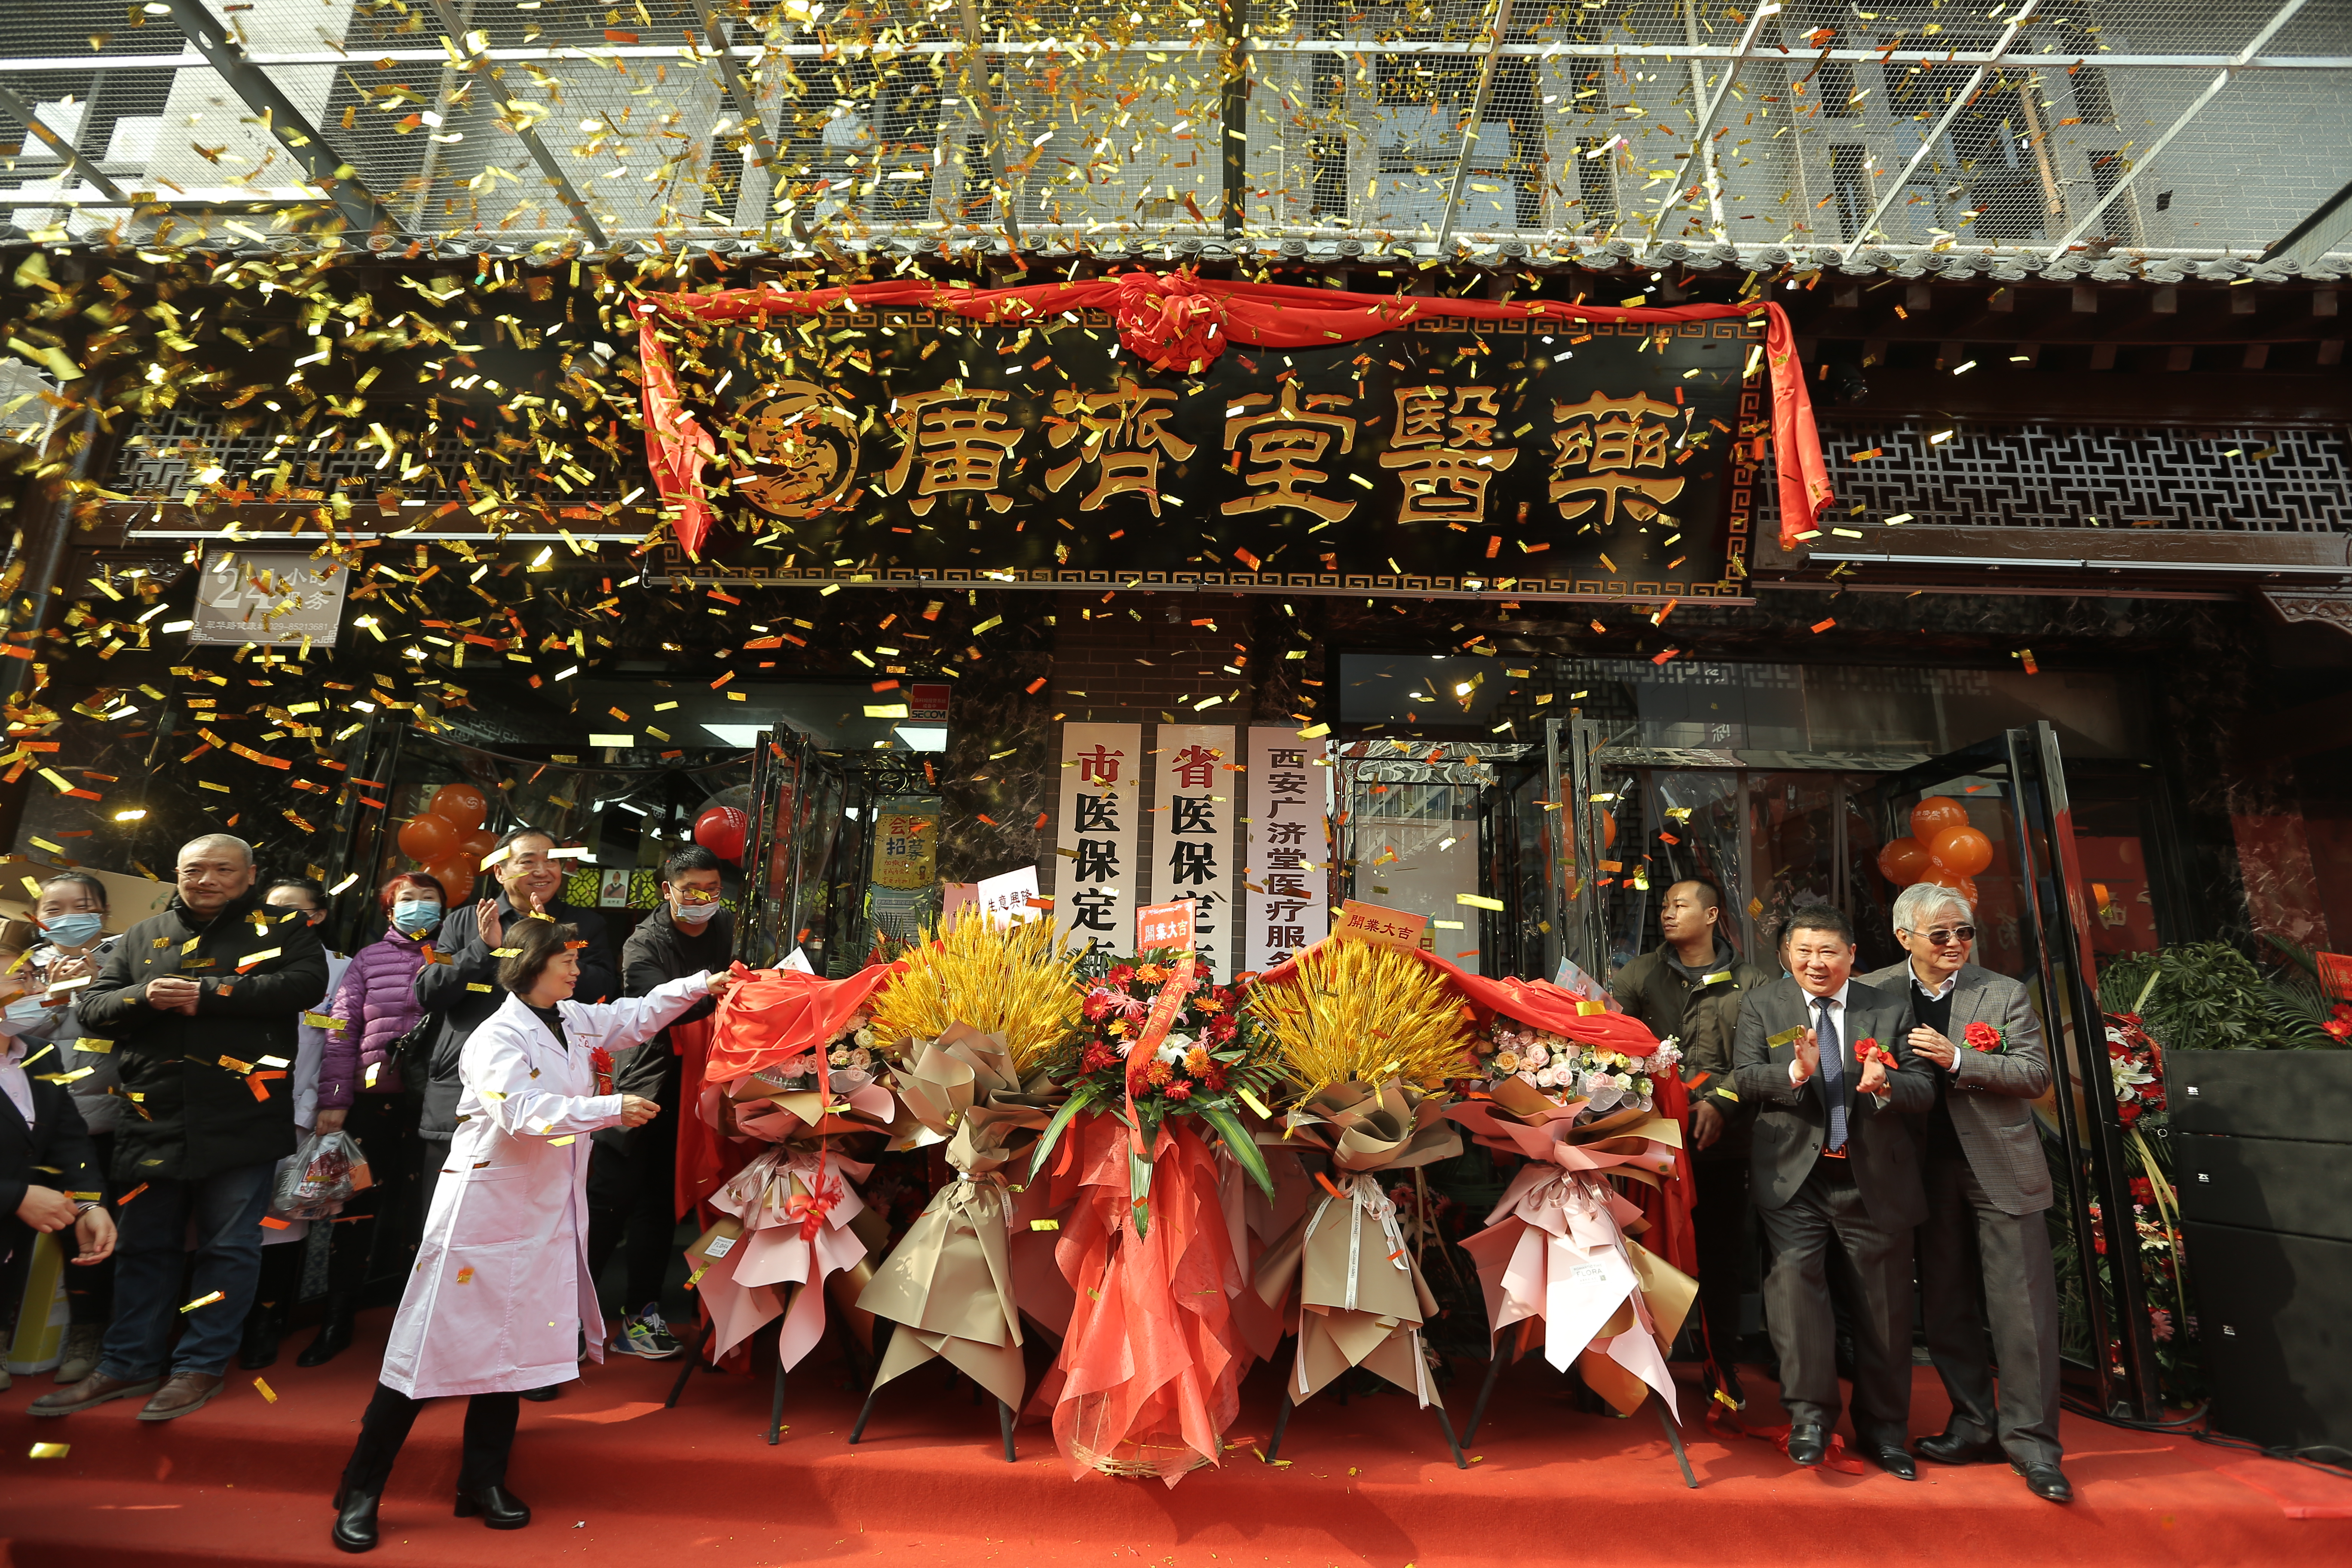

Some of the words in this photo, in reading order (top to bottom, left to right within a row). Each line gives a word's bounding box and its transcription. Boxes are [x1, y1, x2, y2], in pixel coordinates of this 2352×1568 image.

[887, 377, 1685, 525] 廣濟堂醫藥
[912, 710, 946, 719] SECOM
[886, 837, 925, 861] 招募
[1169, 745, 1219, 957] 省医保定
[1347, 915, 1414, 940] 開業大吉
[1576, 1268, 1602, 1277] FLORA
